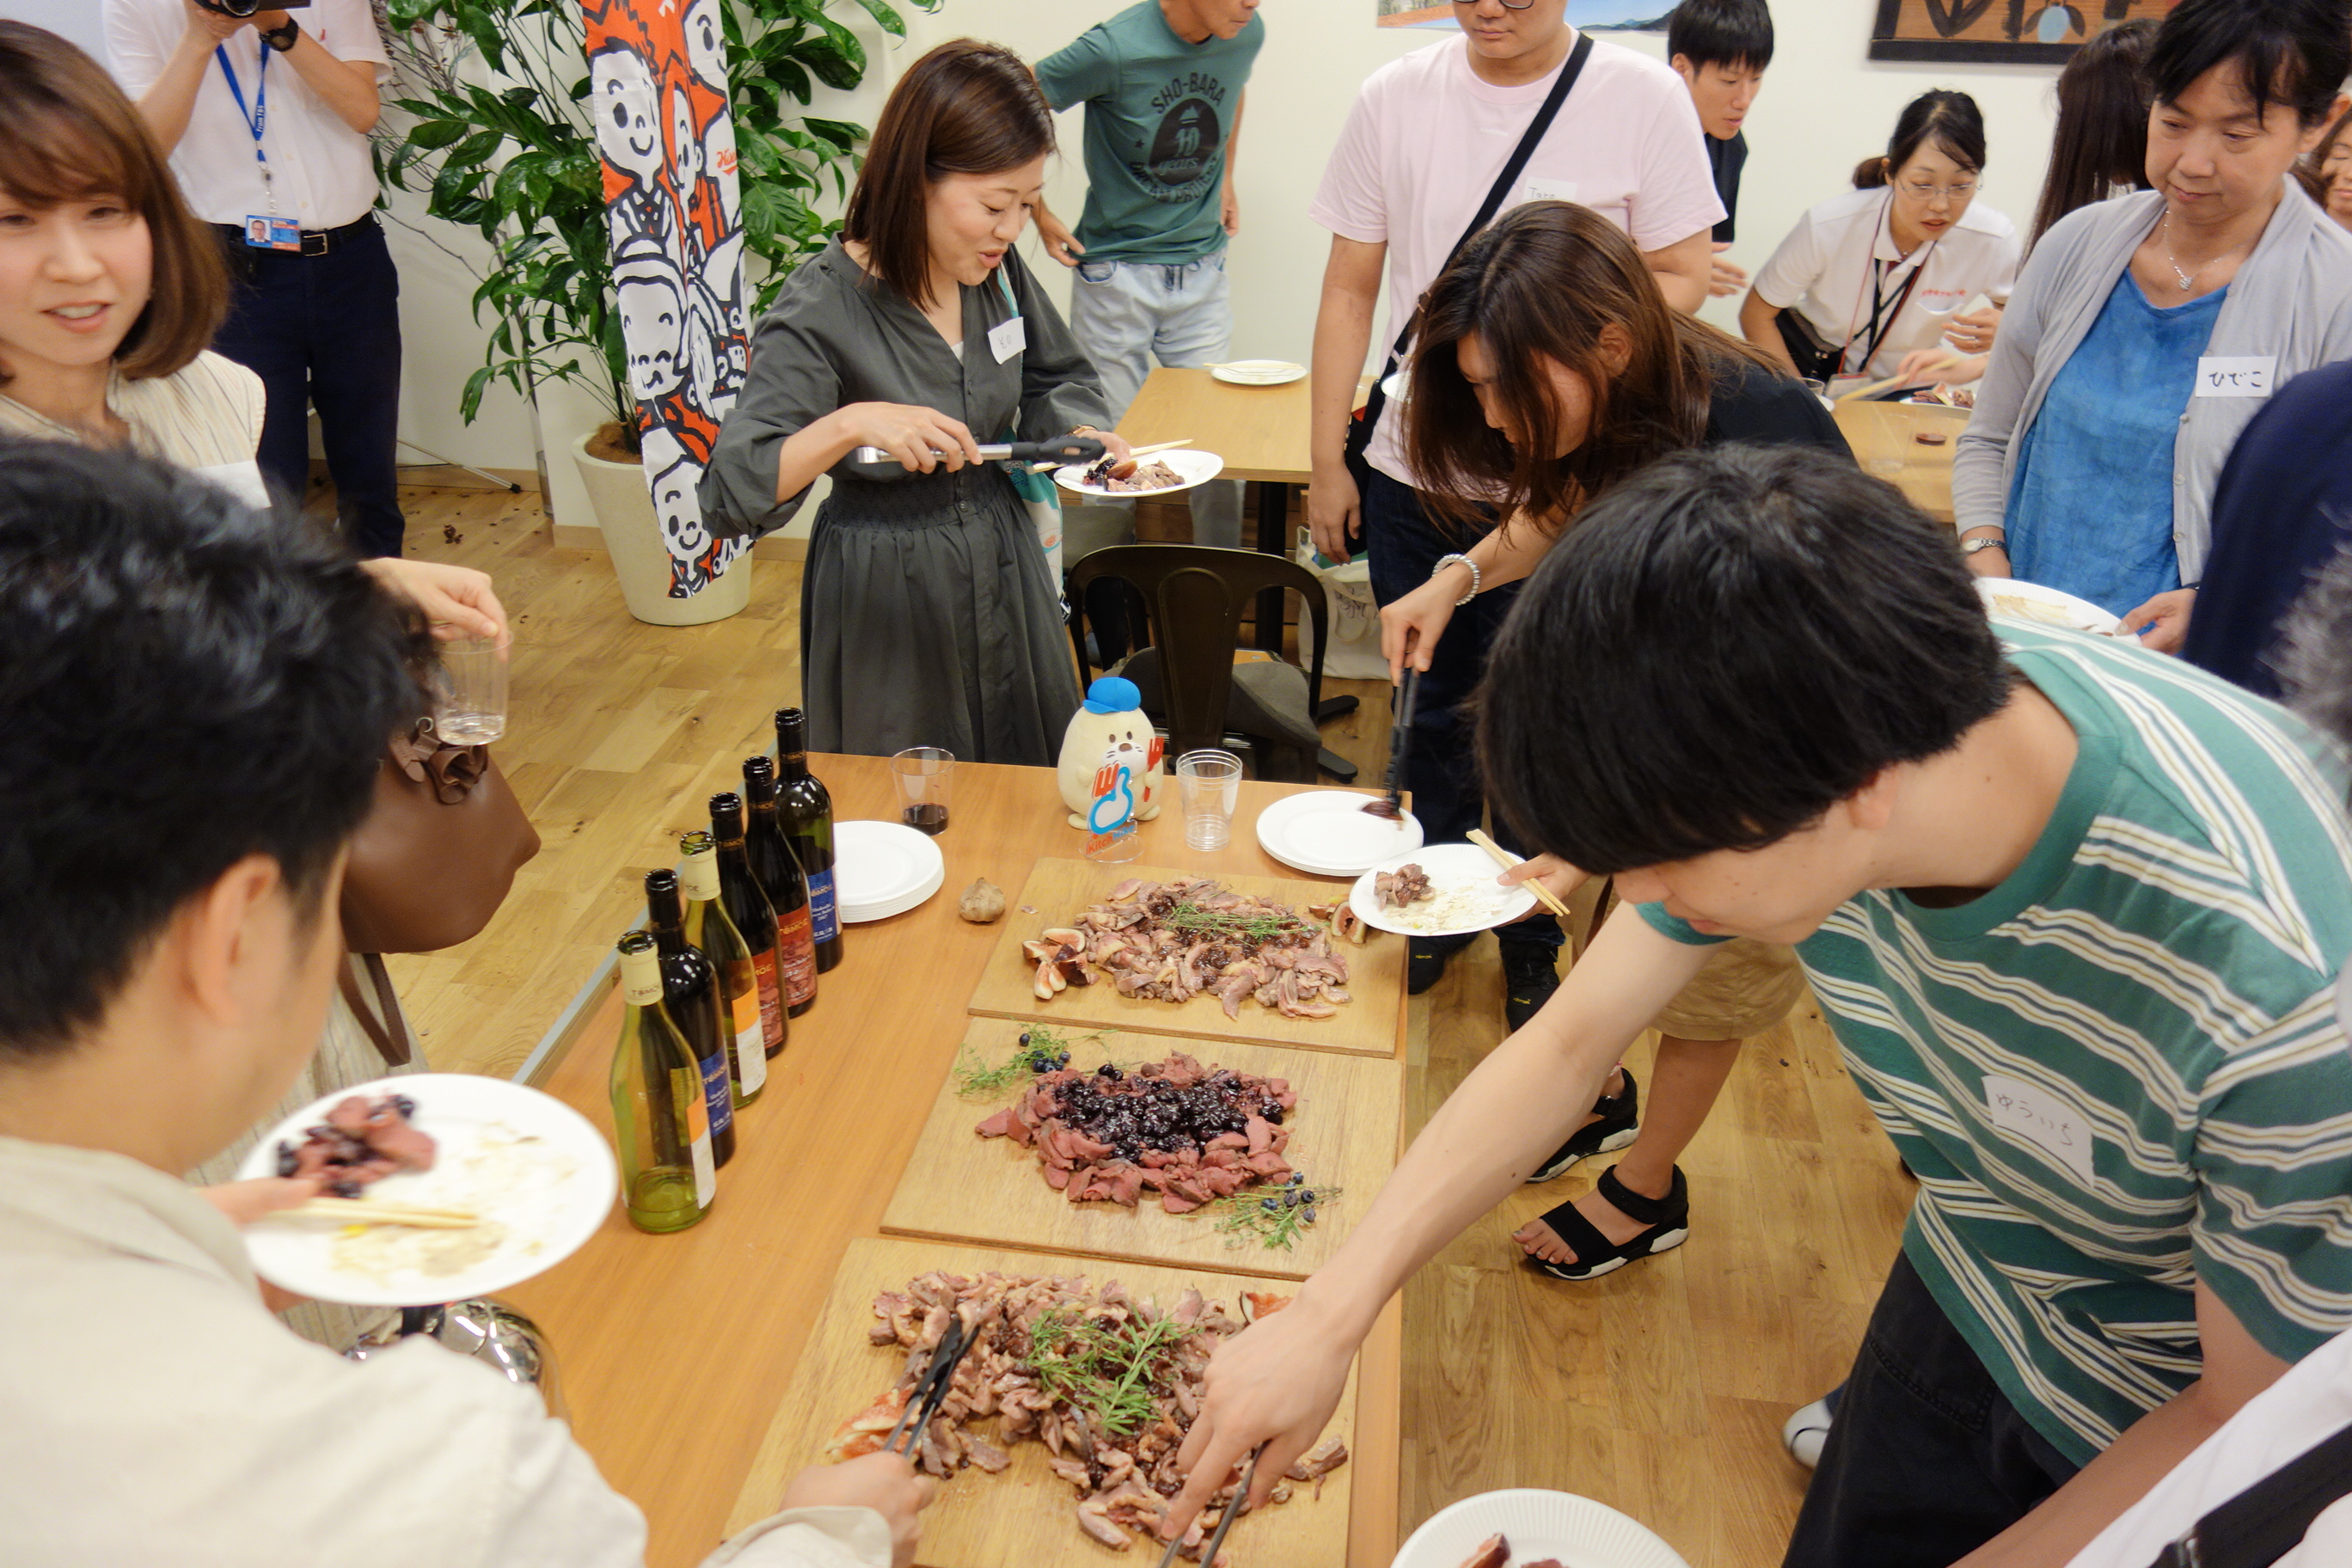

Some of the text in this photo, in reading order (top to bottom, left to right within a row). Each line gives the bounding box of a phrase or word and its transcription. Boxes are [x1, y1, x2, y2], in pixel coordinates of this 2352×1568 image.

[1151, 71, 1226, 114] SHO-BARA
[2208, 371, 2262, 388] ひでこ
[1995, 1093, 2073, 1147] ゆういち
